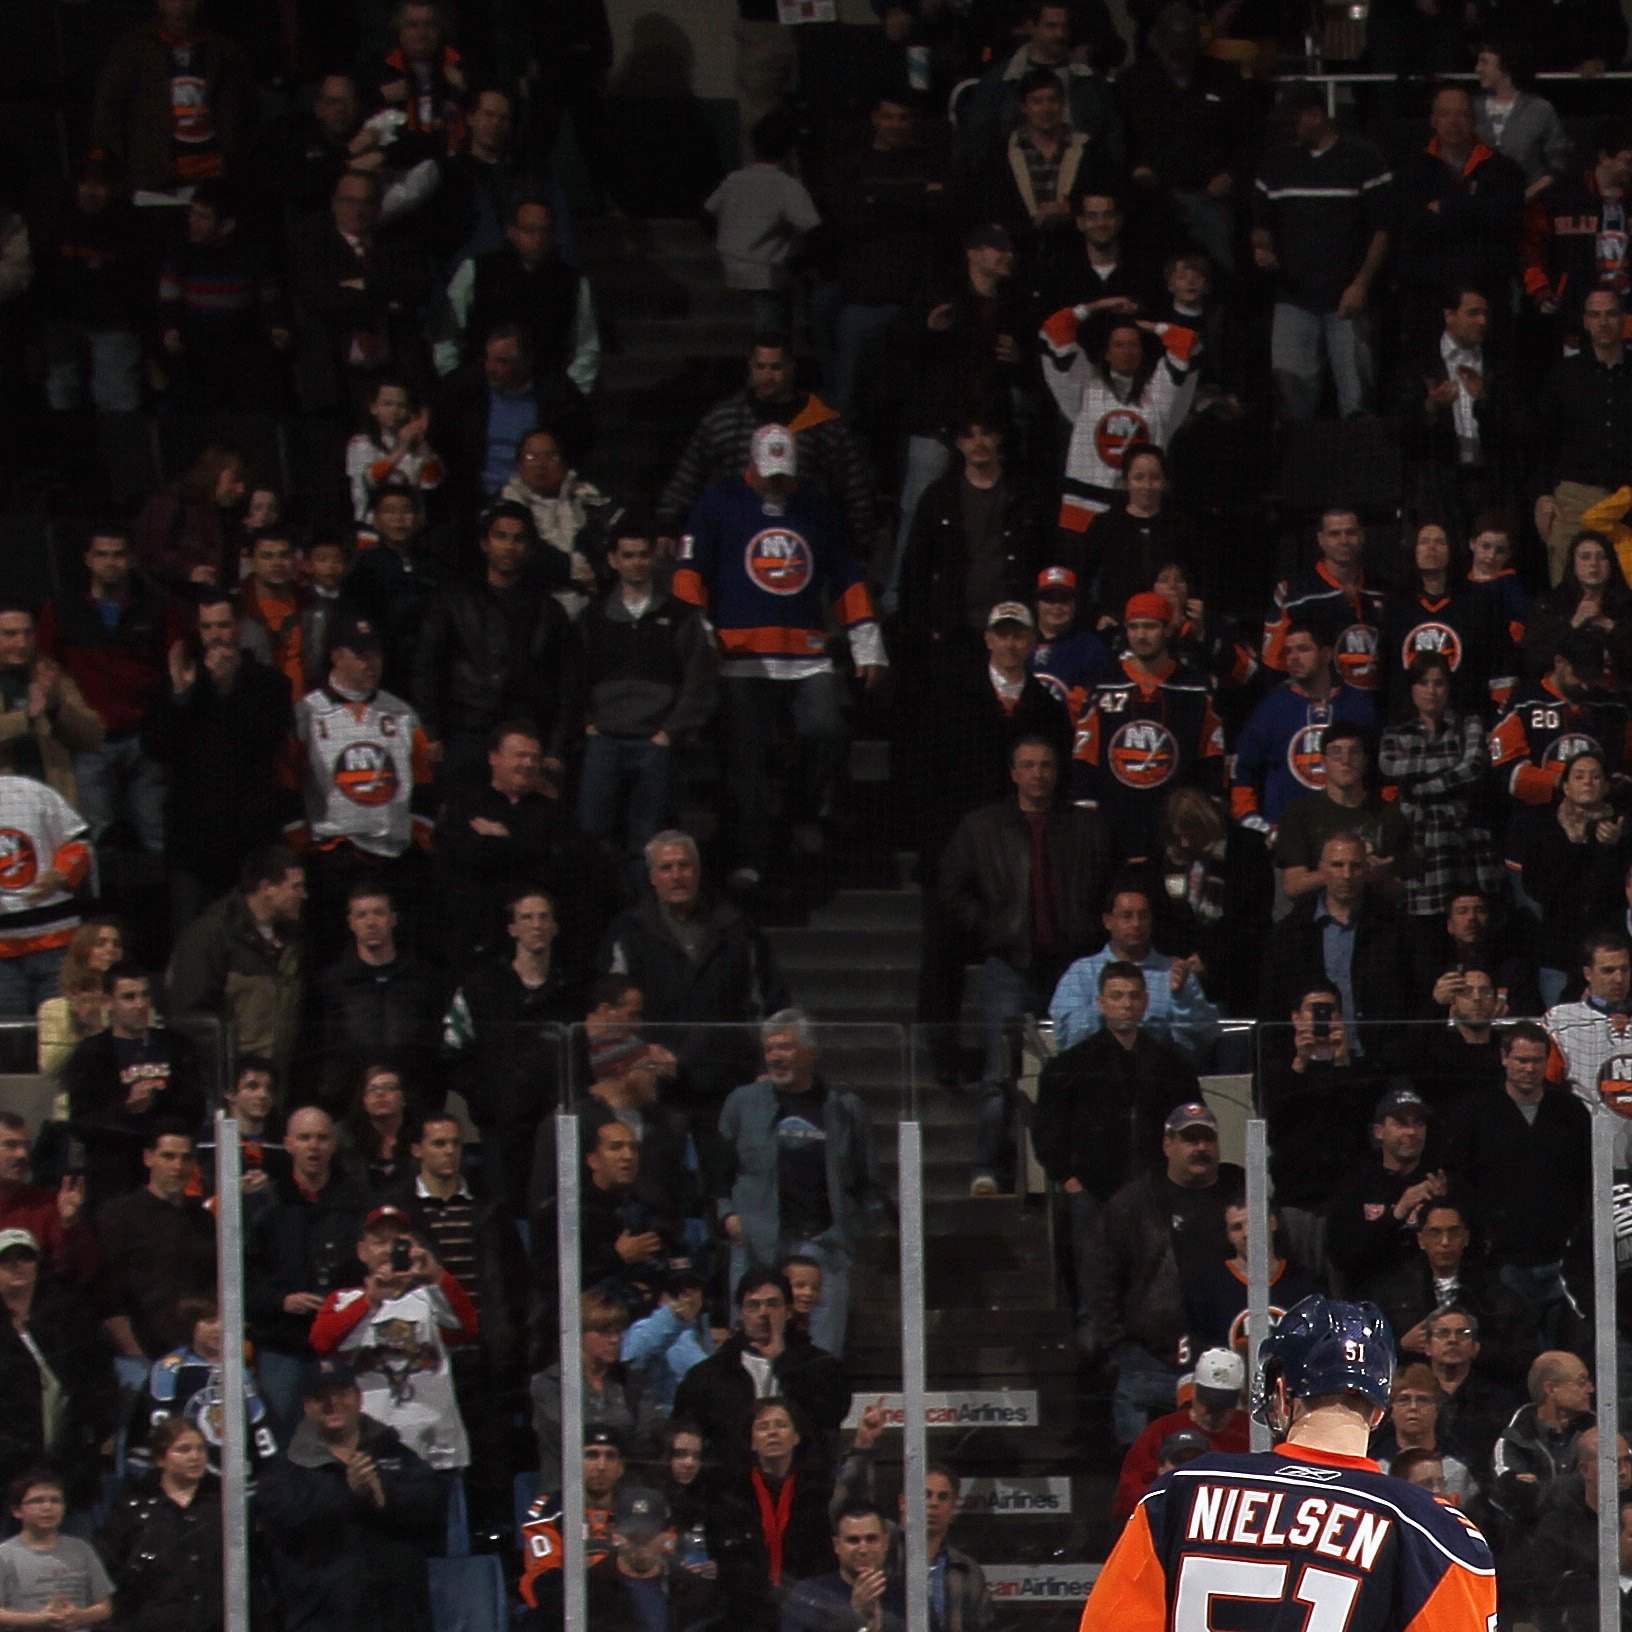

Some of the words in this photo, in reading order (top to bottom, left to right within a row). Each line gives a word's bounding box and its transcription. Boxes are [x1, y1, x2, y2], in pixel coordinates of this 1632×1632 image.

[1098, 692, 1129, 713] 47
[1531, 709, 1561, 730] 20
[1123, 726, 1171, 751] NY
[1344, 1340, 1366, 1364] 51
[1188, 1486, 1391, 1571] NIELSEN
